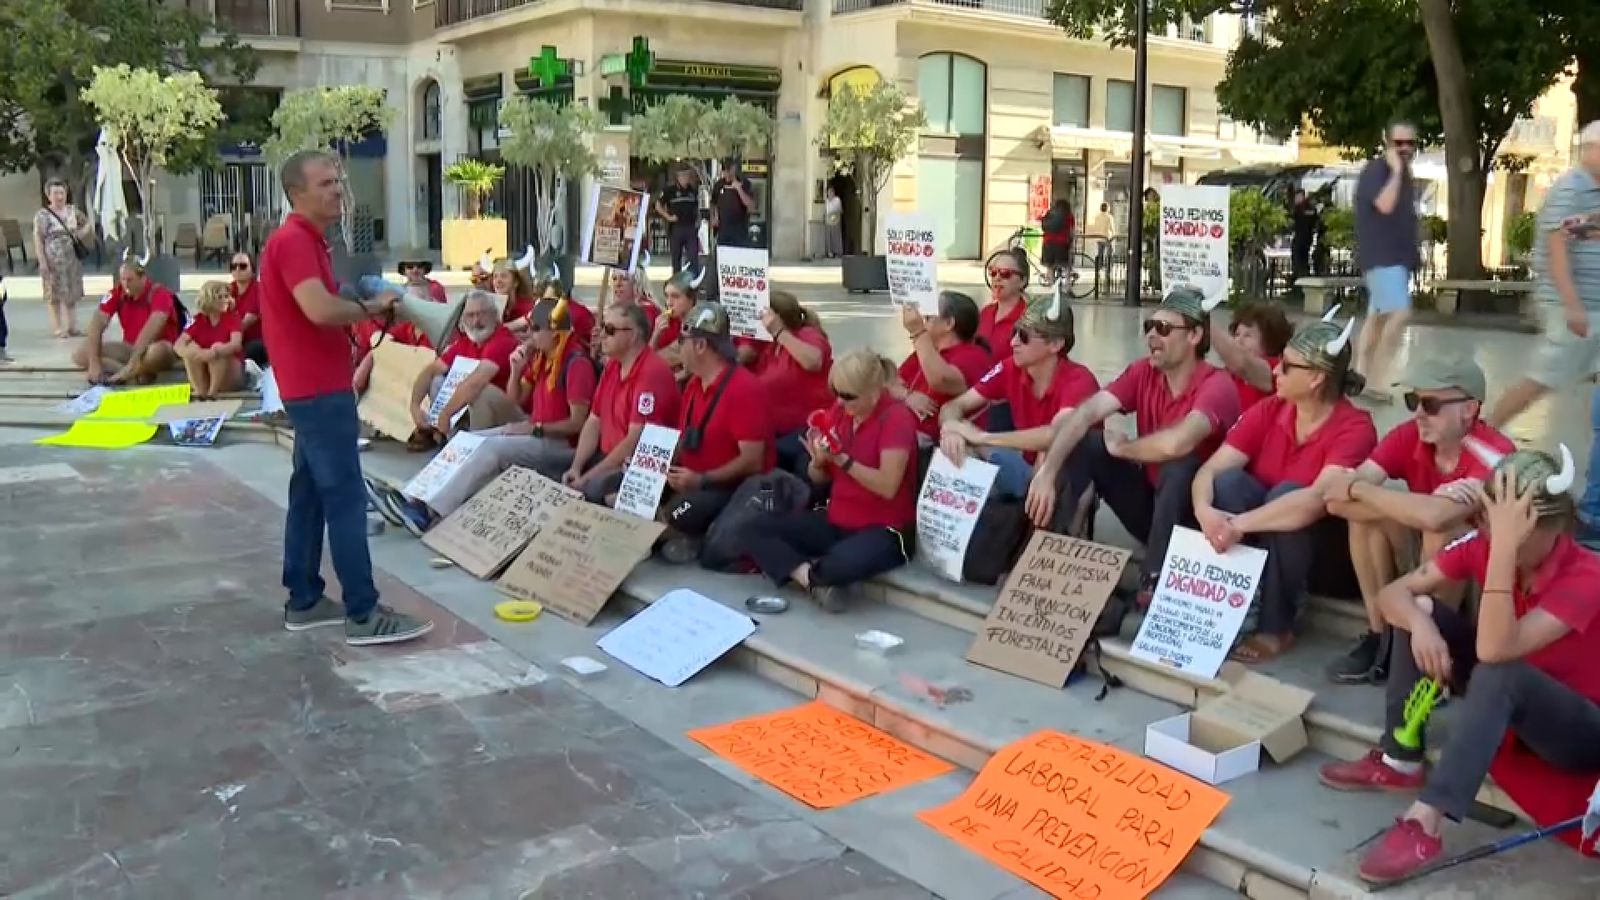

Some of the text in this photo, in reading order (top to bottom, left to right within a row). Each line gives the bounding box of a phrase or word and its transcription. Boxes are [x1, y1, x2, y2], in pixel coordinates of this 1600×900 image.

[1163, 207, 1224, 222] SOLO PEDIMOS
[1164, 220, 1208, 237] DIGNIDAD
[888, 241, 923, 256] DIGNIDAD
[721, 275, 756, 290] DIGNIDAD
[672, 501, 692, 520] FILA
[1018, 573, 1083, 596] PARA LA
[1028, 555, 1110, 582] UNA LIMOSNA
[1169, 555, 1252, 590] SOLO PEDIMOS
[1165, 572, 1228, 603] DIGNIDAD
[997, 607, 1078, 640] INCENDIOS
[1009, 590, 1092, 624] PREVENCIÓN
[986, 627, 1074, 663] FORESTALES
[769, 716, 903, 782] OPERATIVOS
[817, 716, 926, 766] SIEMPRE
[1035, 736, 1191, 811] ESTABILIDAD
[1004, 752, 1175, 855] LABORAL PARA
[974, 788, 1161, 889] UNA PREVENCIÓN
[950, 816, 1102, 900] DE CALIDAD
